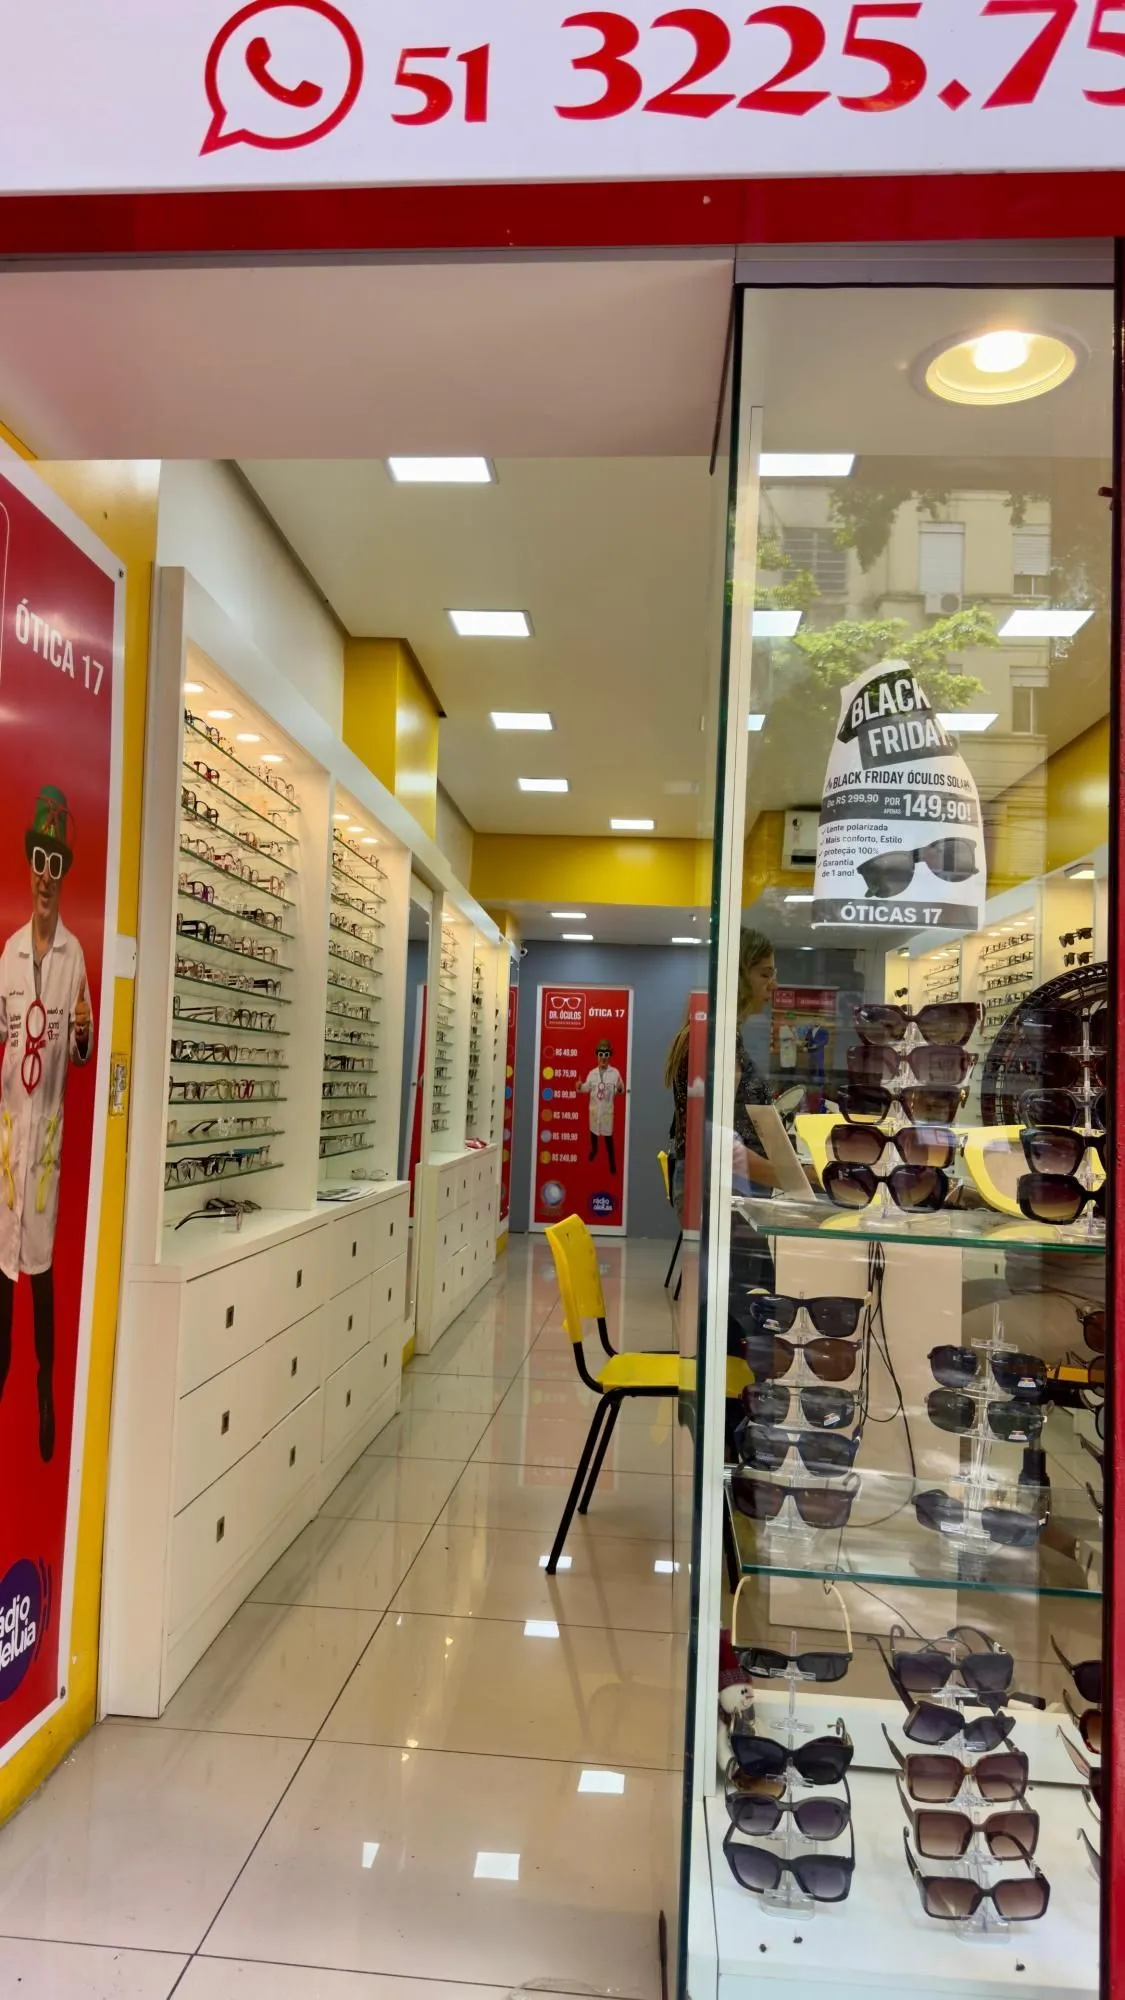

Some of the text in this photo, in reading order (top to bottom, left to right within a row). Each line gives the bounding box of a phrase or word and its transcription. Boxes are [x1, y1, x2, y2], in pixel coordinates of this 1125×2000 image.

[391, 43, 489, 126] 51
[15, 598, 104, 696] ÓTICA 17
[851, 678, 932, 729] BLACK
[832, 770, 862, 790] BLACK
[864, 770, 904, 785] FRIDAY
[907, 769, 945, 786] ÓCULOS
[847, 793, 879, 804] 299,90
[884, 796, 900, 806] POR
[903, 793, 972, 822] 149,90!
[846, 823, 888, 833] polarizada
[825, 834, 902, 845] Mais conforto, Estilo
[823, 846, 856, 857] proteção
[822, 859, 854, 868] Garantia
[821, 870, 830, 878] de
[837, 869, 855, 878] ano!
[840, 902, 943, 924] ÓTICAS 17
[560, 1009, 581, 1020] ÓCULOS
[588, 1006, 612, 1017] ÓTICA
[614, 1009, 625, 1018] 17
